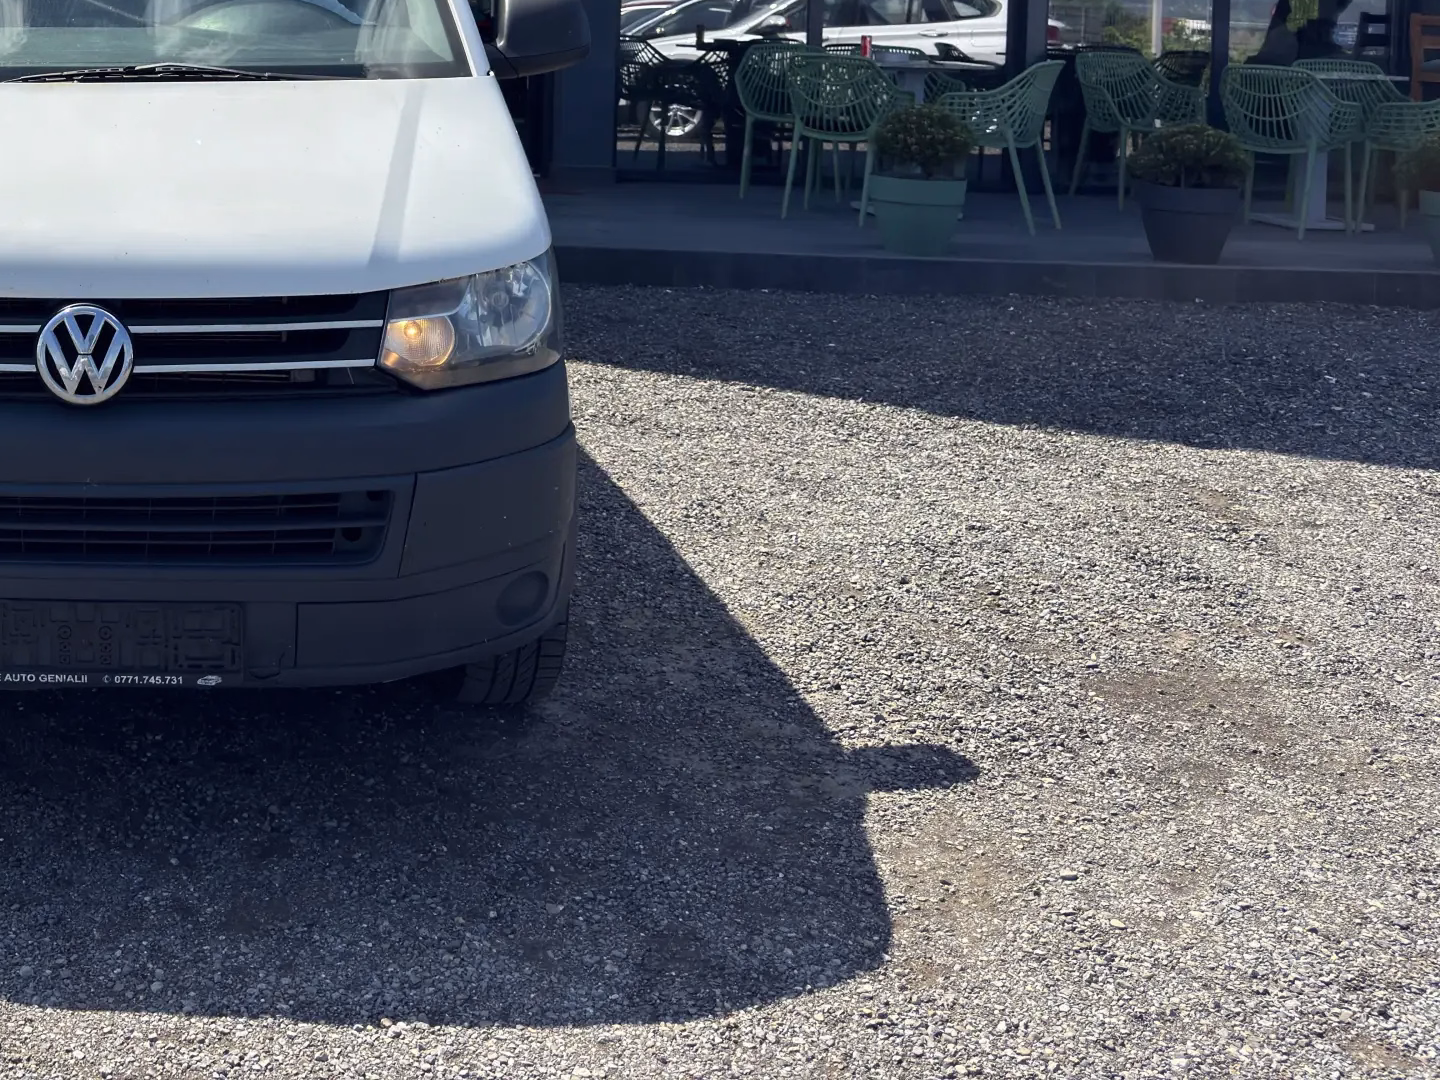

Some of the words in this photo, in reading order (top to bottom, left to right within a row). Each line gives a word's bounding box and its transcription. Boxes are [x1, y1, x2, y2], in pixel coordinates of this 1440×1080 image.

[37, 304, 133, 404] VW
[4, 673, 36, 682] AUTO
[114, 675, 183, 685] 0771.745.731
